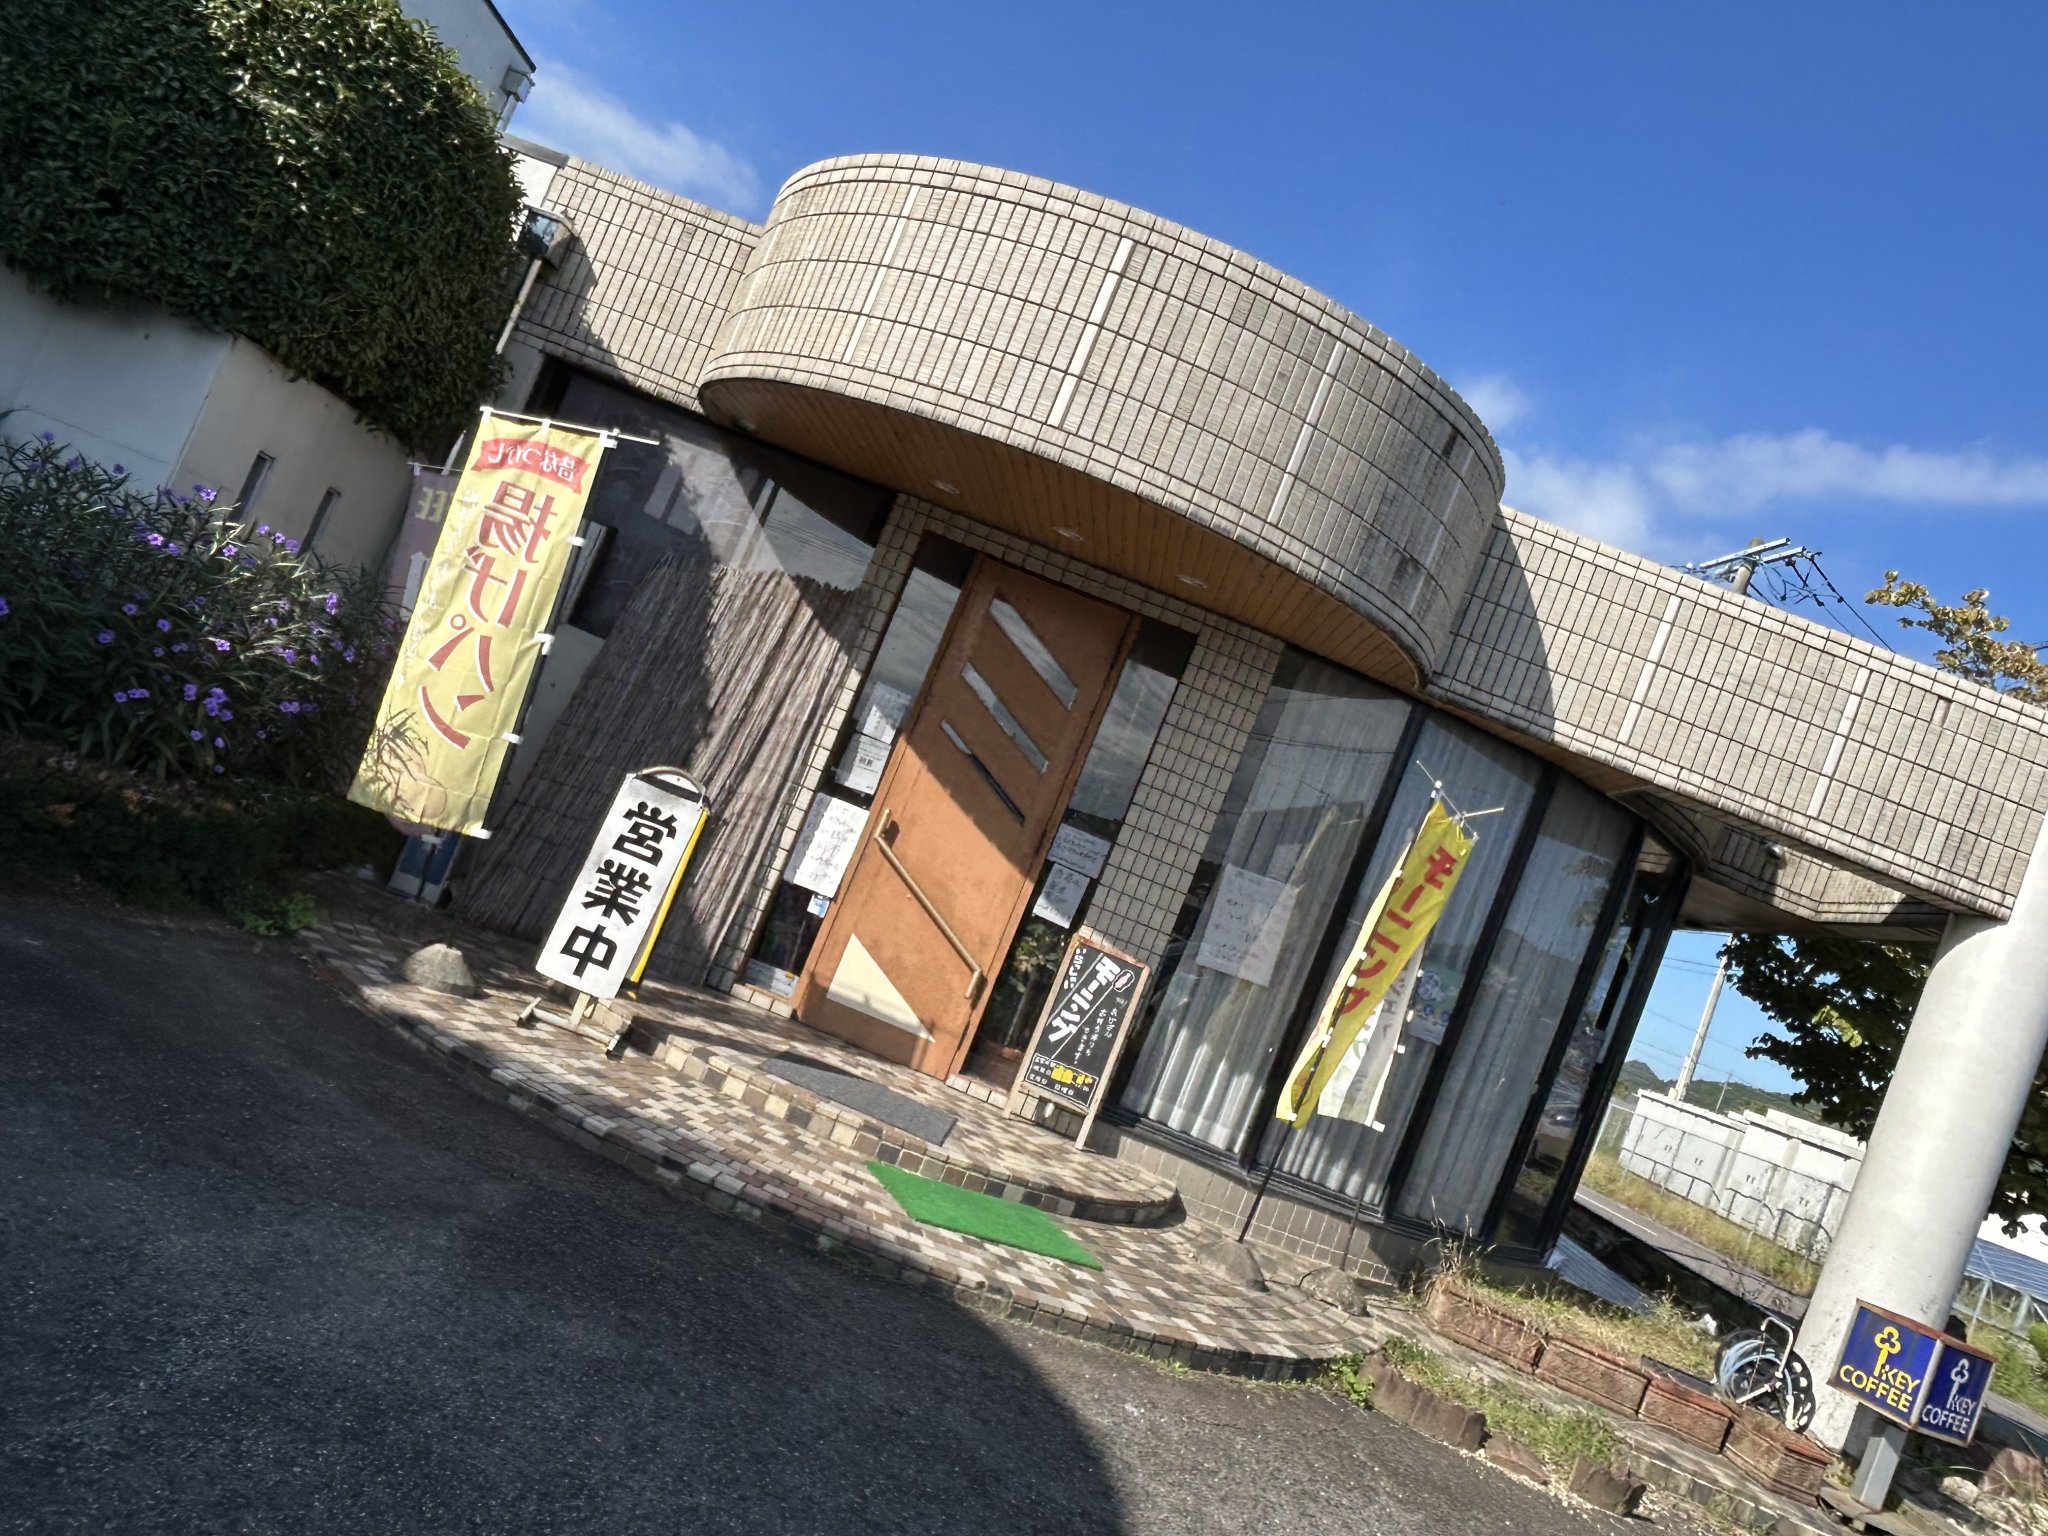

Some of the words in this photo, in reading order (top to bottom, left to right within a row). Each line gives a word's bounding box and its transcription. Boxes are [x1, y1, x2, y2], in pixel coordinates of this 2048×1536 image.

[560, 801, 678, 978] 営業中
[1839, 1364, 1913, 1413] COFFEE
[1881, 1364, 1920, 1393] KEY
[1921, 1404, 1970, 1434] COFFEE
[1951, 1394, 1976, 1416] KEY
